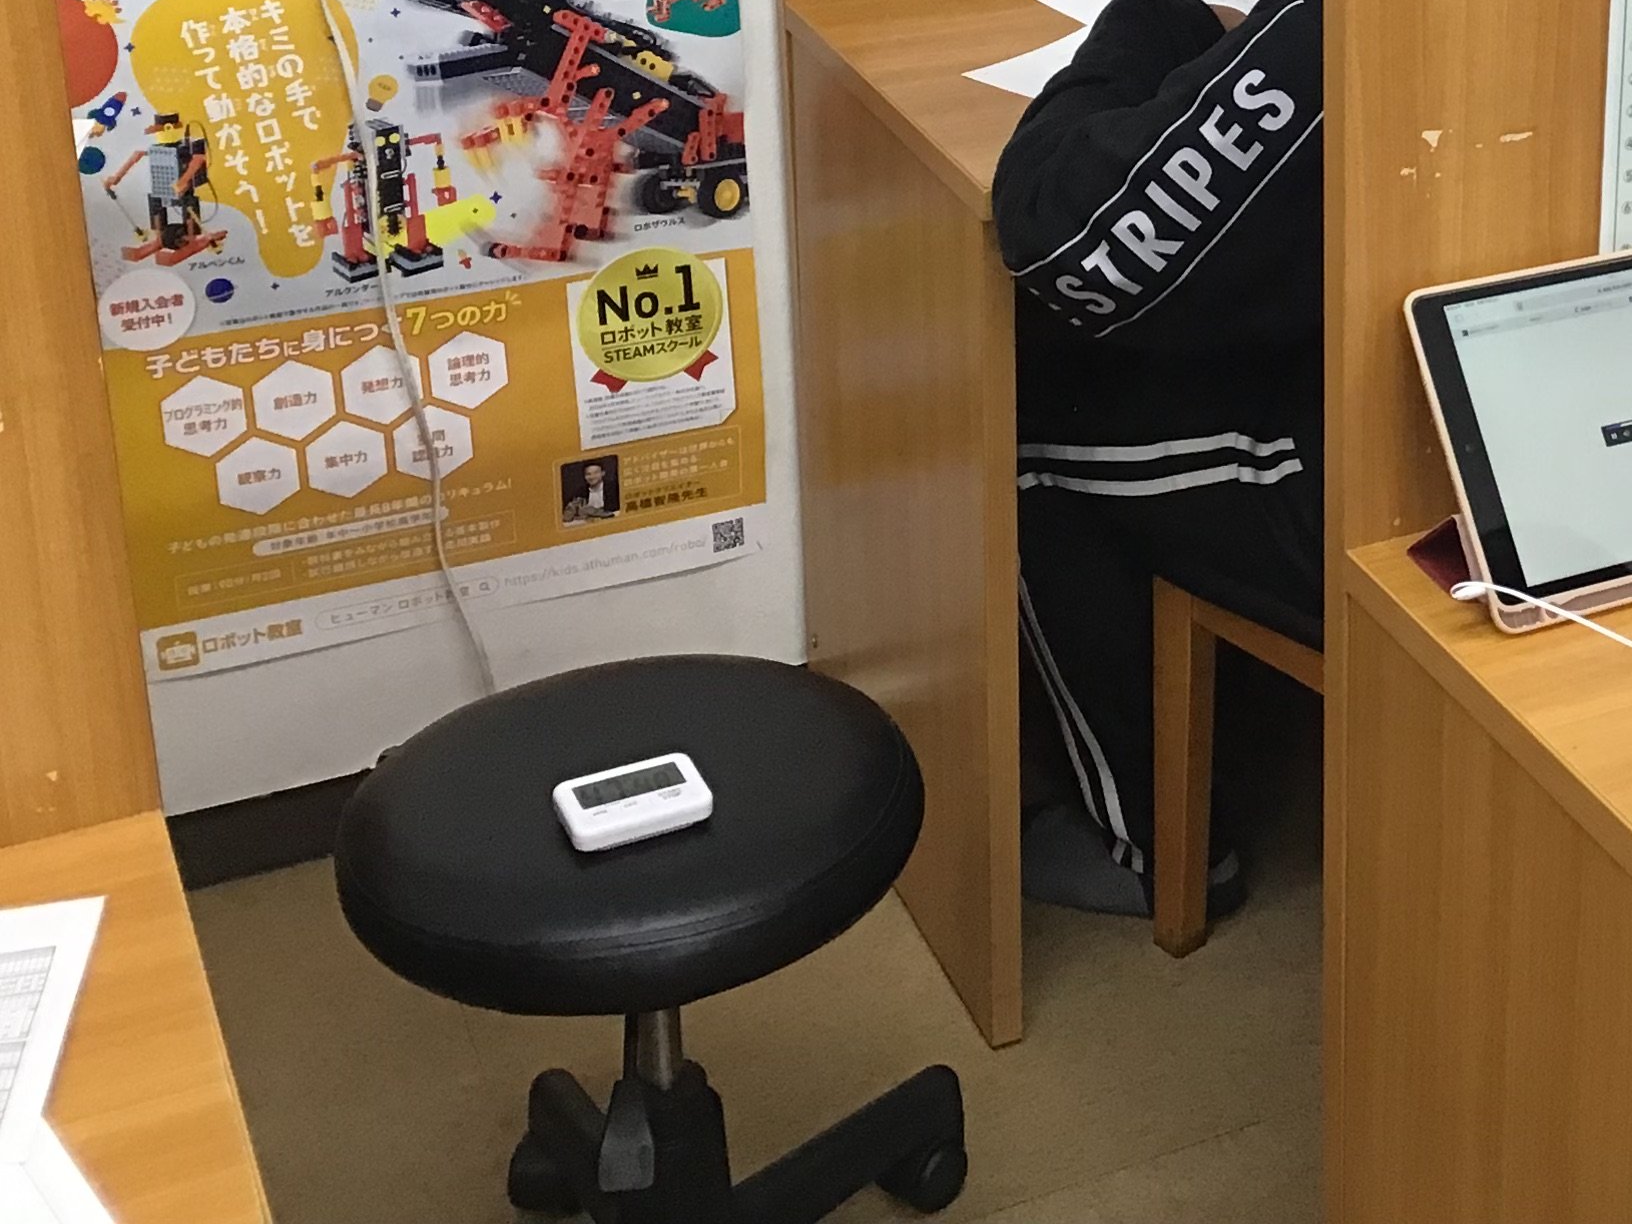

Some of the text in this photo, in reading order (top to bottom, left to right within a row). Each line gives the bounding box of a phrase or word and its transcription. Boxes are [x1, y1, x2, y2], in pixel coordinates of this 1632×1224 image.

[260, 0, 321, 131] キミの手で
[219, 7, 315, 248] 本格的なロボットを
[1055, 68, 1295, 314] STRIPES
[109, 293, 184, 317] 新規入会者
[596, 264, 701, 327] No.1
[600, 314, 704, 346] ロボット教室
[603, 334, 703, 364] STEAMスクール
[447, 352, 490, 372] 論理的
[361, 375, 404, 394] 発想力
[448, 369, 491, 388] 思考力
[164, 398, 243, 422] プログラミング的
[273, 391, 318, 411] 創造力
[183, 418, 228, 436] 思考力
[324, 450, 368, 470] 集中力
[330, 602, 393, 625] ヒューマン
[202, 619, 303, 654] ロボット教室
